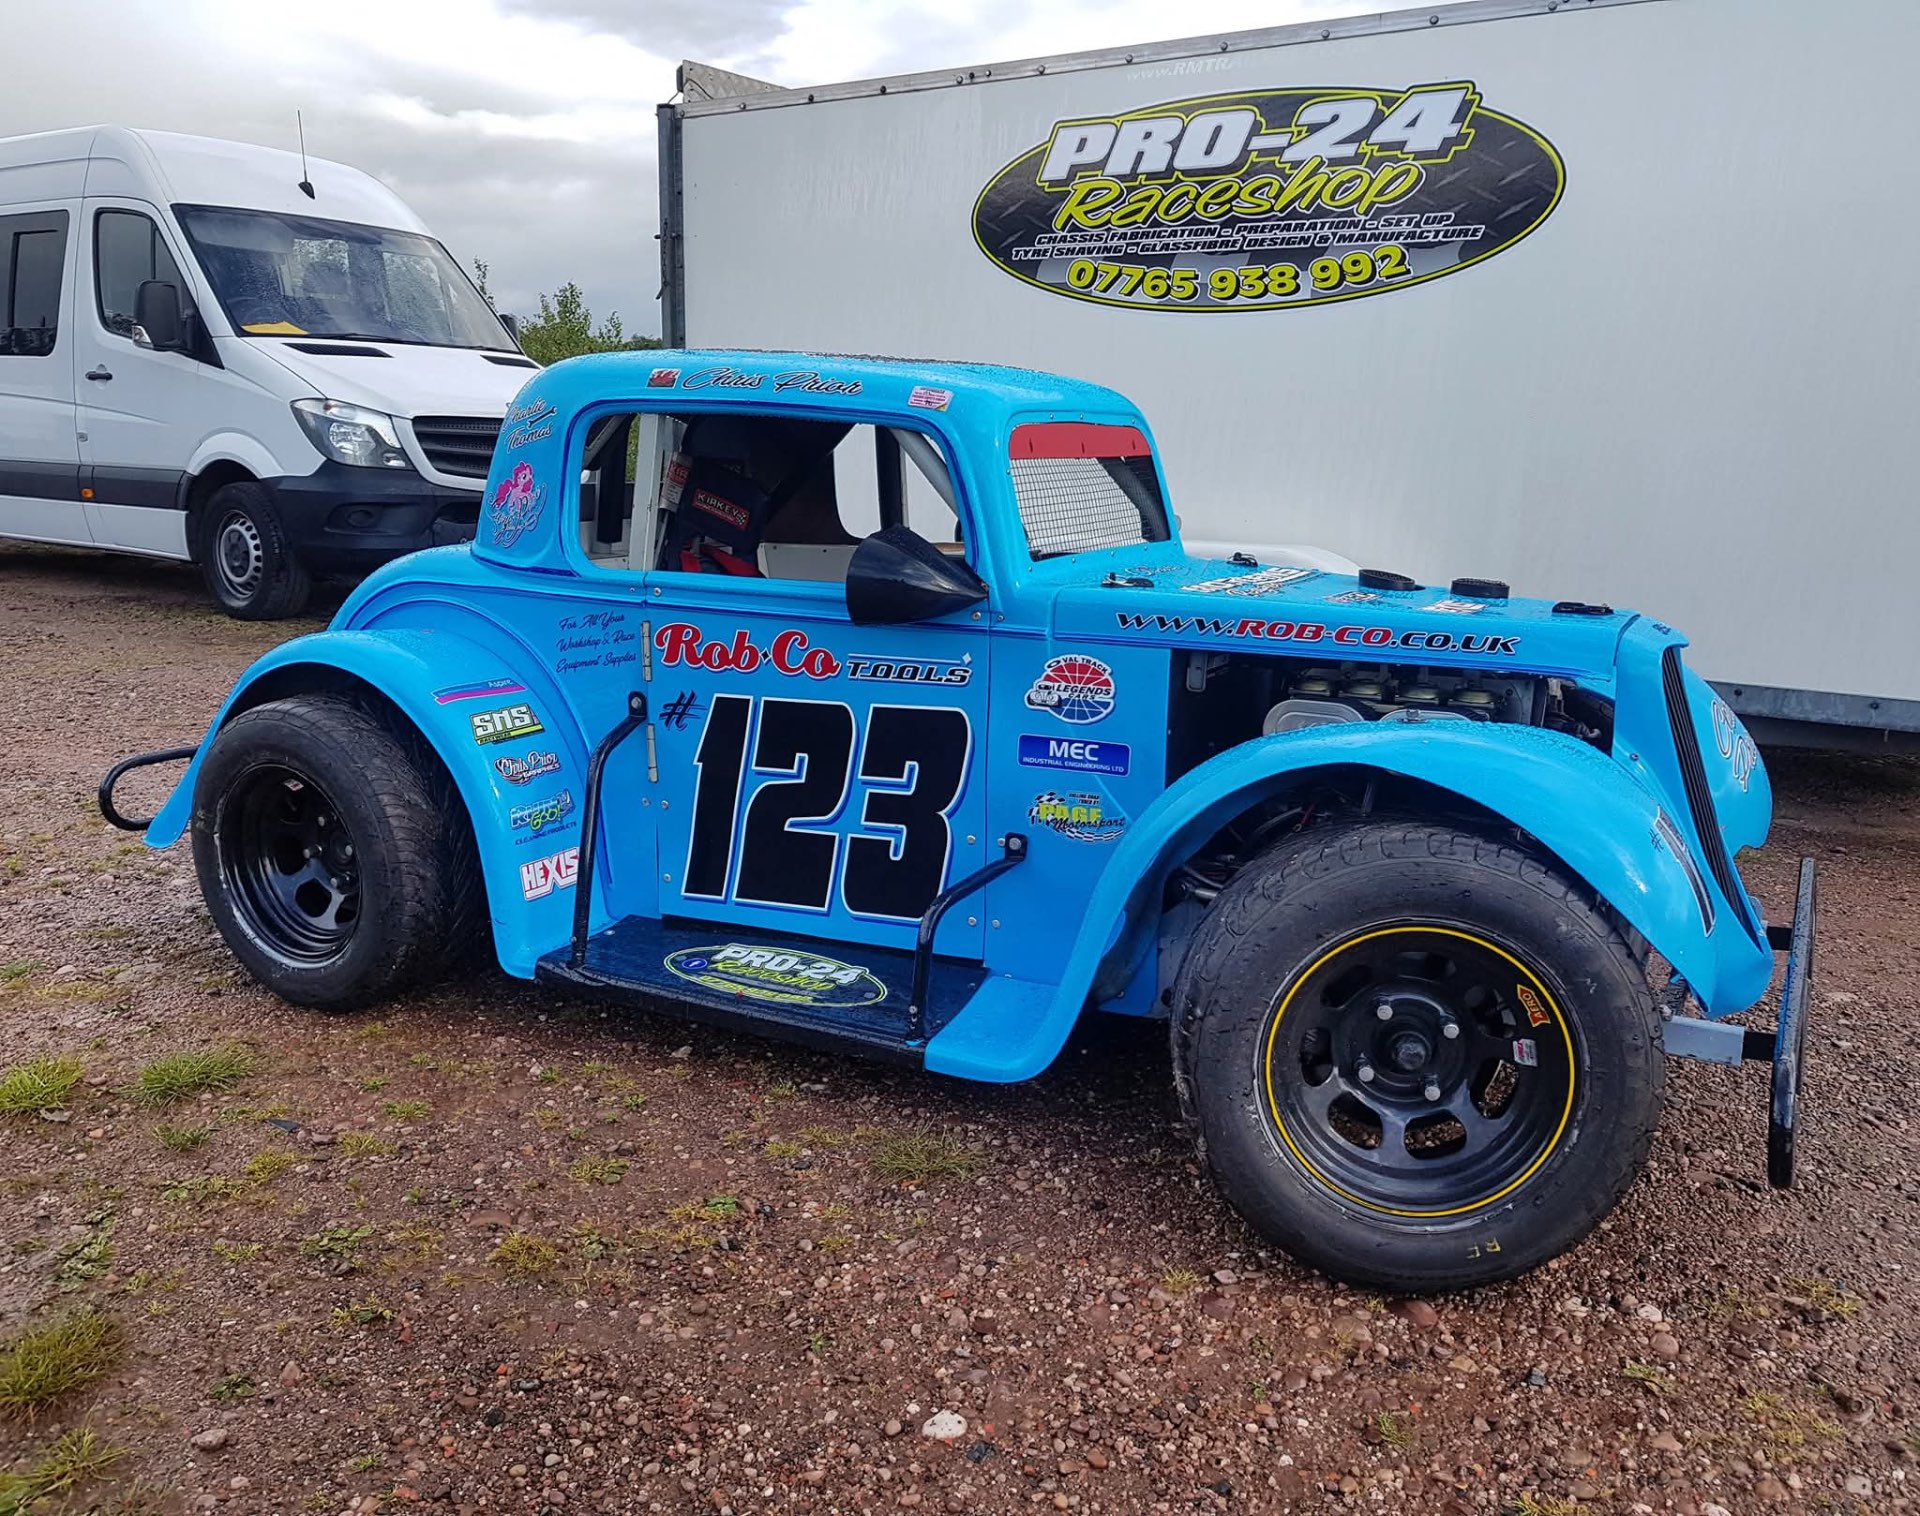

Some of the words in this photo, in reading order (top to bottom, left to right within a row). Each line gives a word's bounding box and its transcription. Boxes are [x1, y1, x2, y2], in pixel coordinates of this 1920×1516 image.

[1040, 88, 1467, 181] PRO-24
[1054, 154, 1422, 232] Raceshop
[1012, 249, 1051, 259] TYRE
[1053, 244, 1125, 256] SHAVING
[1138, 238, 1240, 253] GLASSFIBRE
[1244, 233, 1312, 247] DESIGN
[1315, 234, 1331, 245] &
[1335, 226, 1485, 244] MANUFACTURE
[1036, 232, 1106, 246] CHASSIS
[1108, 226, 1220, 242] FABRICATION
[1234, 218, 1361, 236] PREPARATION
[1381, 216, 1416, 228] SET
[1422, 214, 1452, 226] UP
[1067, 259, 1200, 300] 07765
[1208, 264, 1301, 300] 938
[1310, 244, 1412, 290] 992
[682, 367, 768, 390] Chris
[773, 371, 863, 395] Prior
[697, 493, 739, 517] KIRKEY
[558, 615, 577, 630] For
[847, 660, 972, 686] TOOLS
[1046, 656, 1079, 668] OVAL
[1080, 657, 1109, 674] TRACK
[1056, 684, 1112, 696] LEGENDS
[1067, 692, 1096, 701] CARS
[1049, 740, 1099, 761] MEC
[1023, 757, 1062, 766] INDUSTRIAL
[1064, 761, 1110, 771] ENGINEERING
[1111, 765, 1124, 773] LTD
[681, 692, 974, 922] 123
[522, 850, 579, 892] HEXIS
[711, 946, 862, 984] PRO-24
[1522, 993, 1543, 1019] AERO
